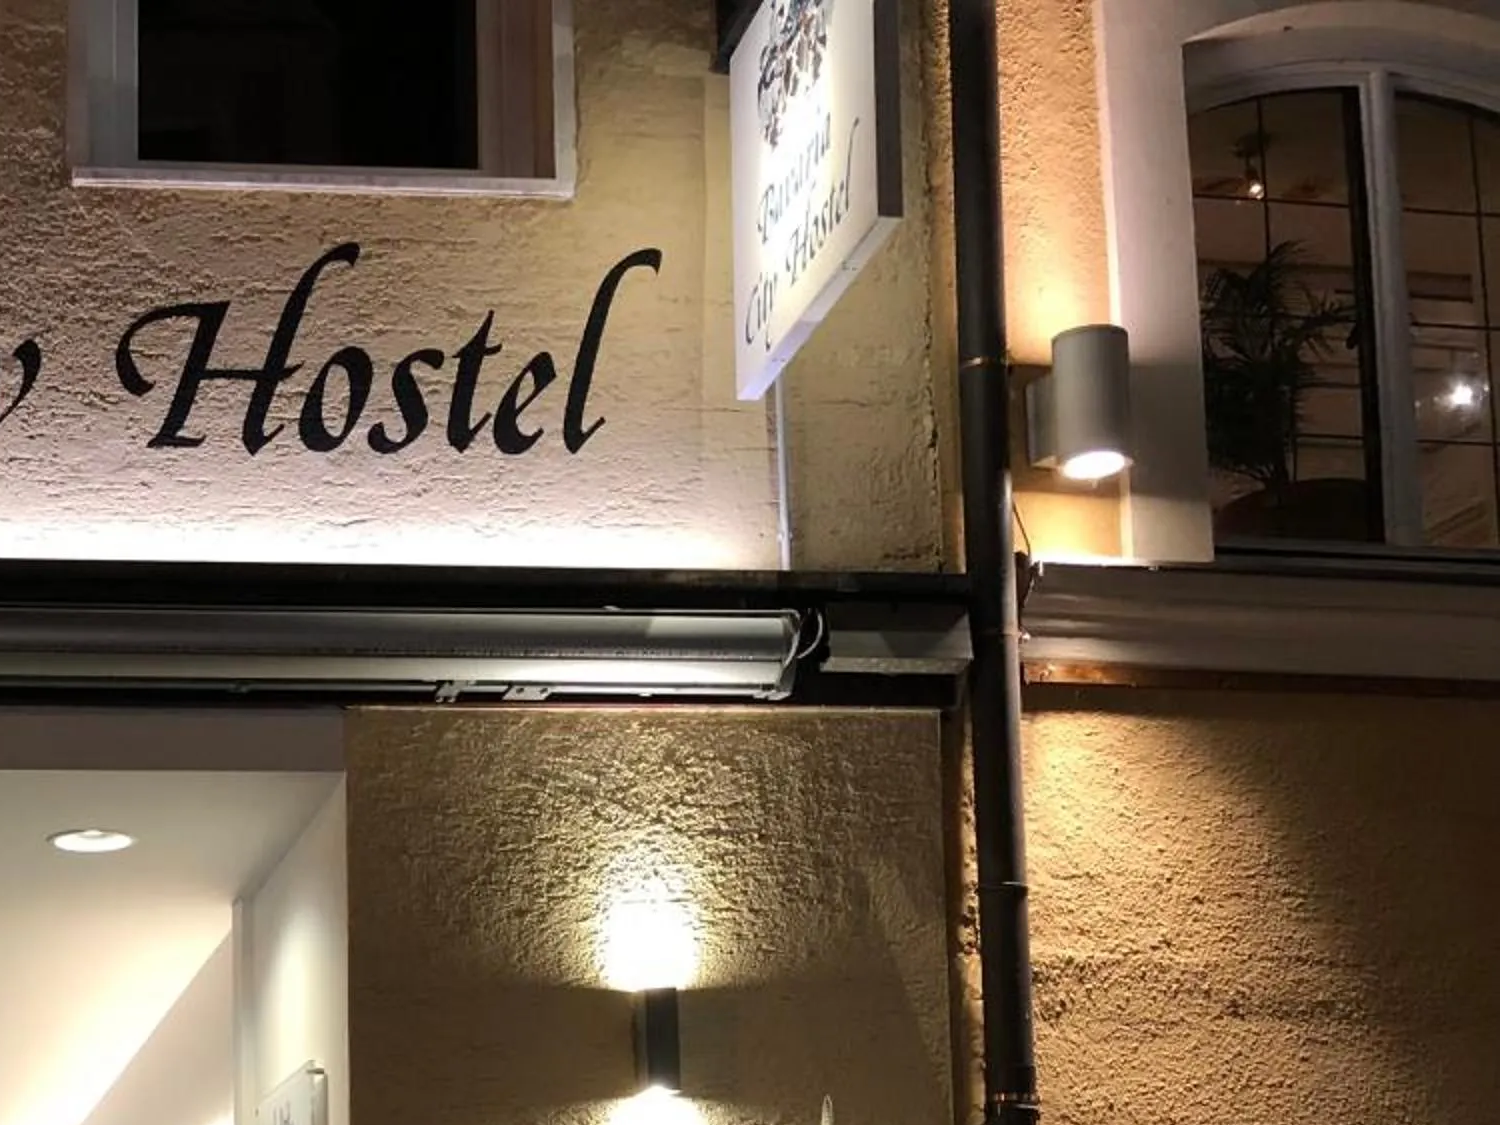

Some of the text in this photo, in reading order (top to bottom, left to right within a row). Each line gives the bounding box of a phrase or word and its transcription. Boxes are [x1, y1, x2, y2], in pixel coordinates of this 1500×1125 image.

[745, 116, 861, 351] City Hostel
[114, 241, 662, 456] Hostel
